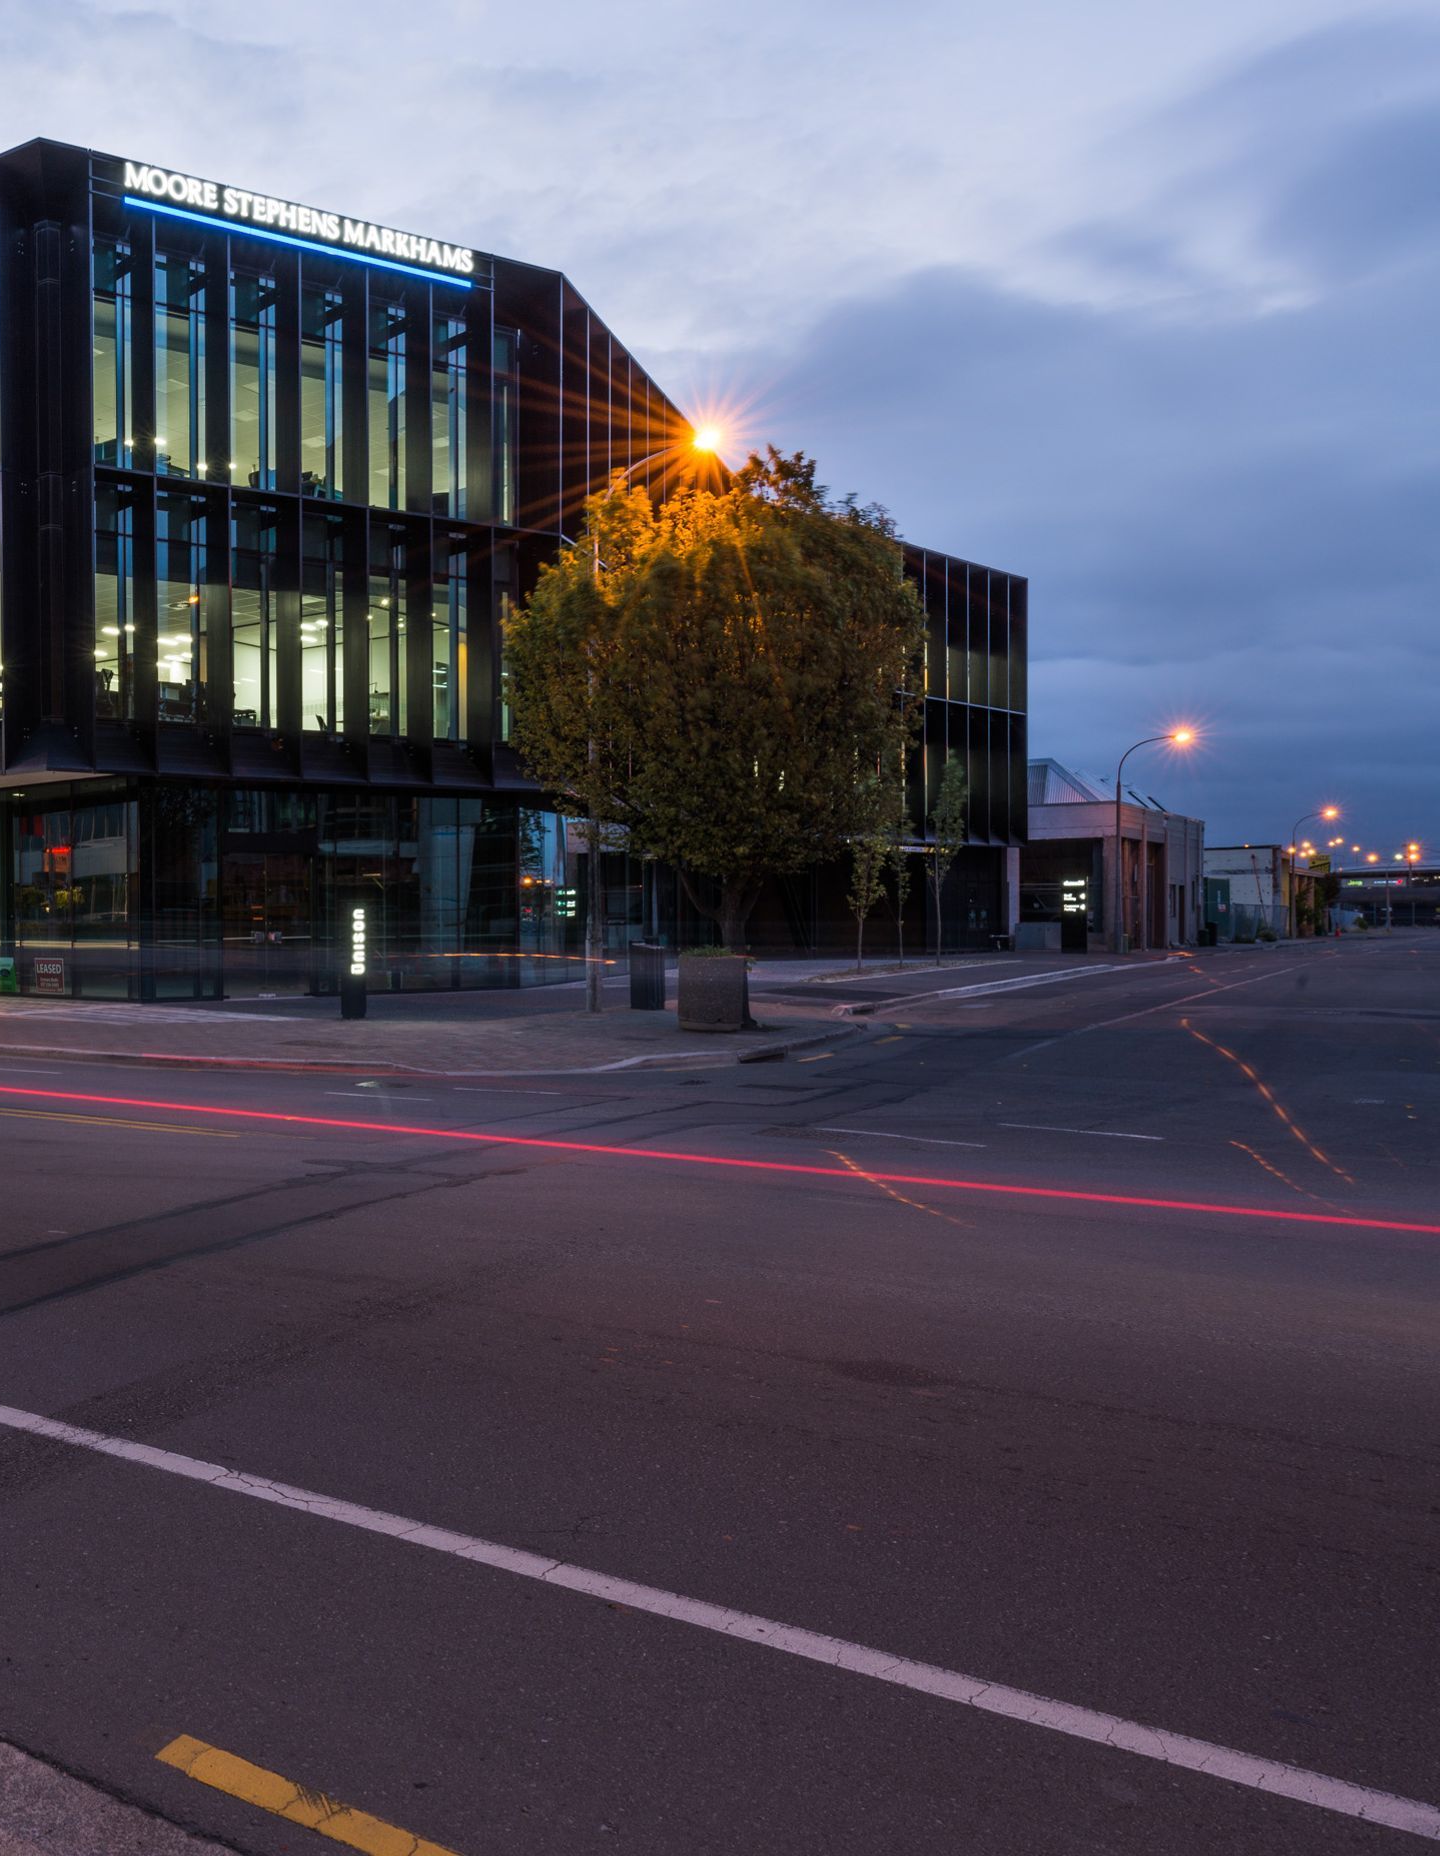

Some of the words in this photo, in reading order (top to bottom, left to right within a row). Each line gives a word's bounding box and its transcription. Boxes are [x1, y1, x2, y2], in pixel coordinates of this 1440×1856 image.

[124, 162, 219, 209] MOORE
[223, 187, 340, 240] STEPHENS
[343, 219, 474, 273] MARKHAMS
[36, 964, 62, 974] LEASED
